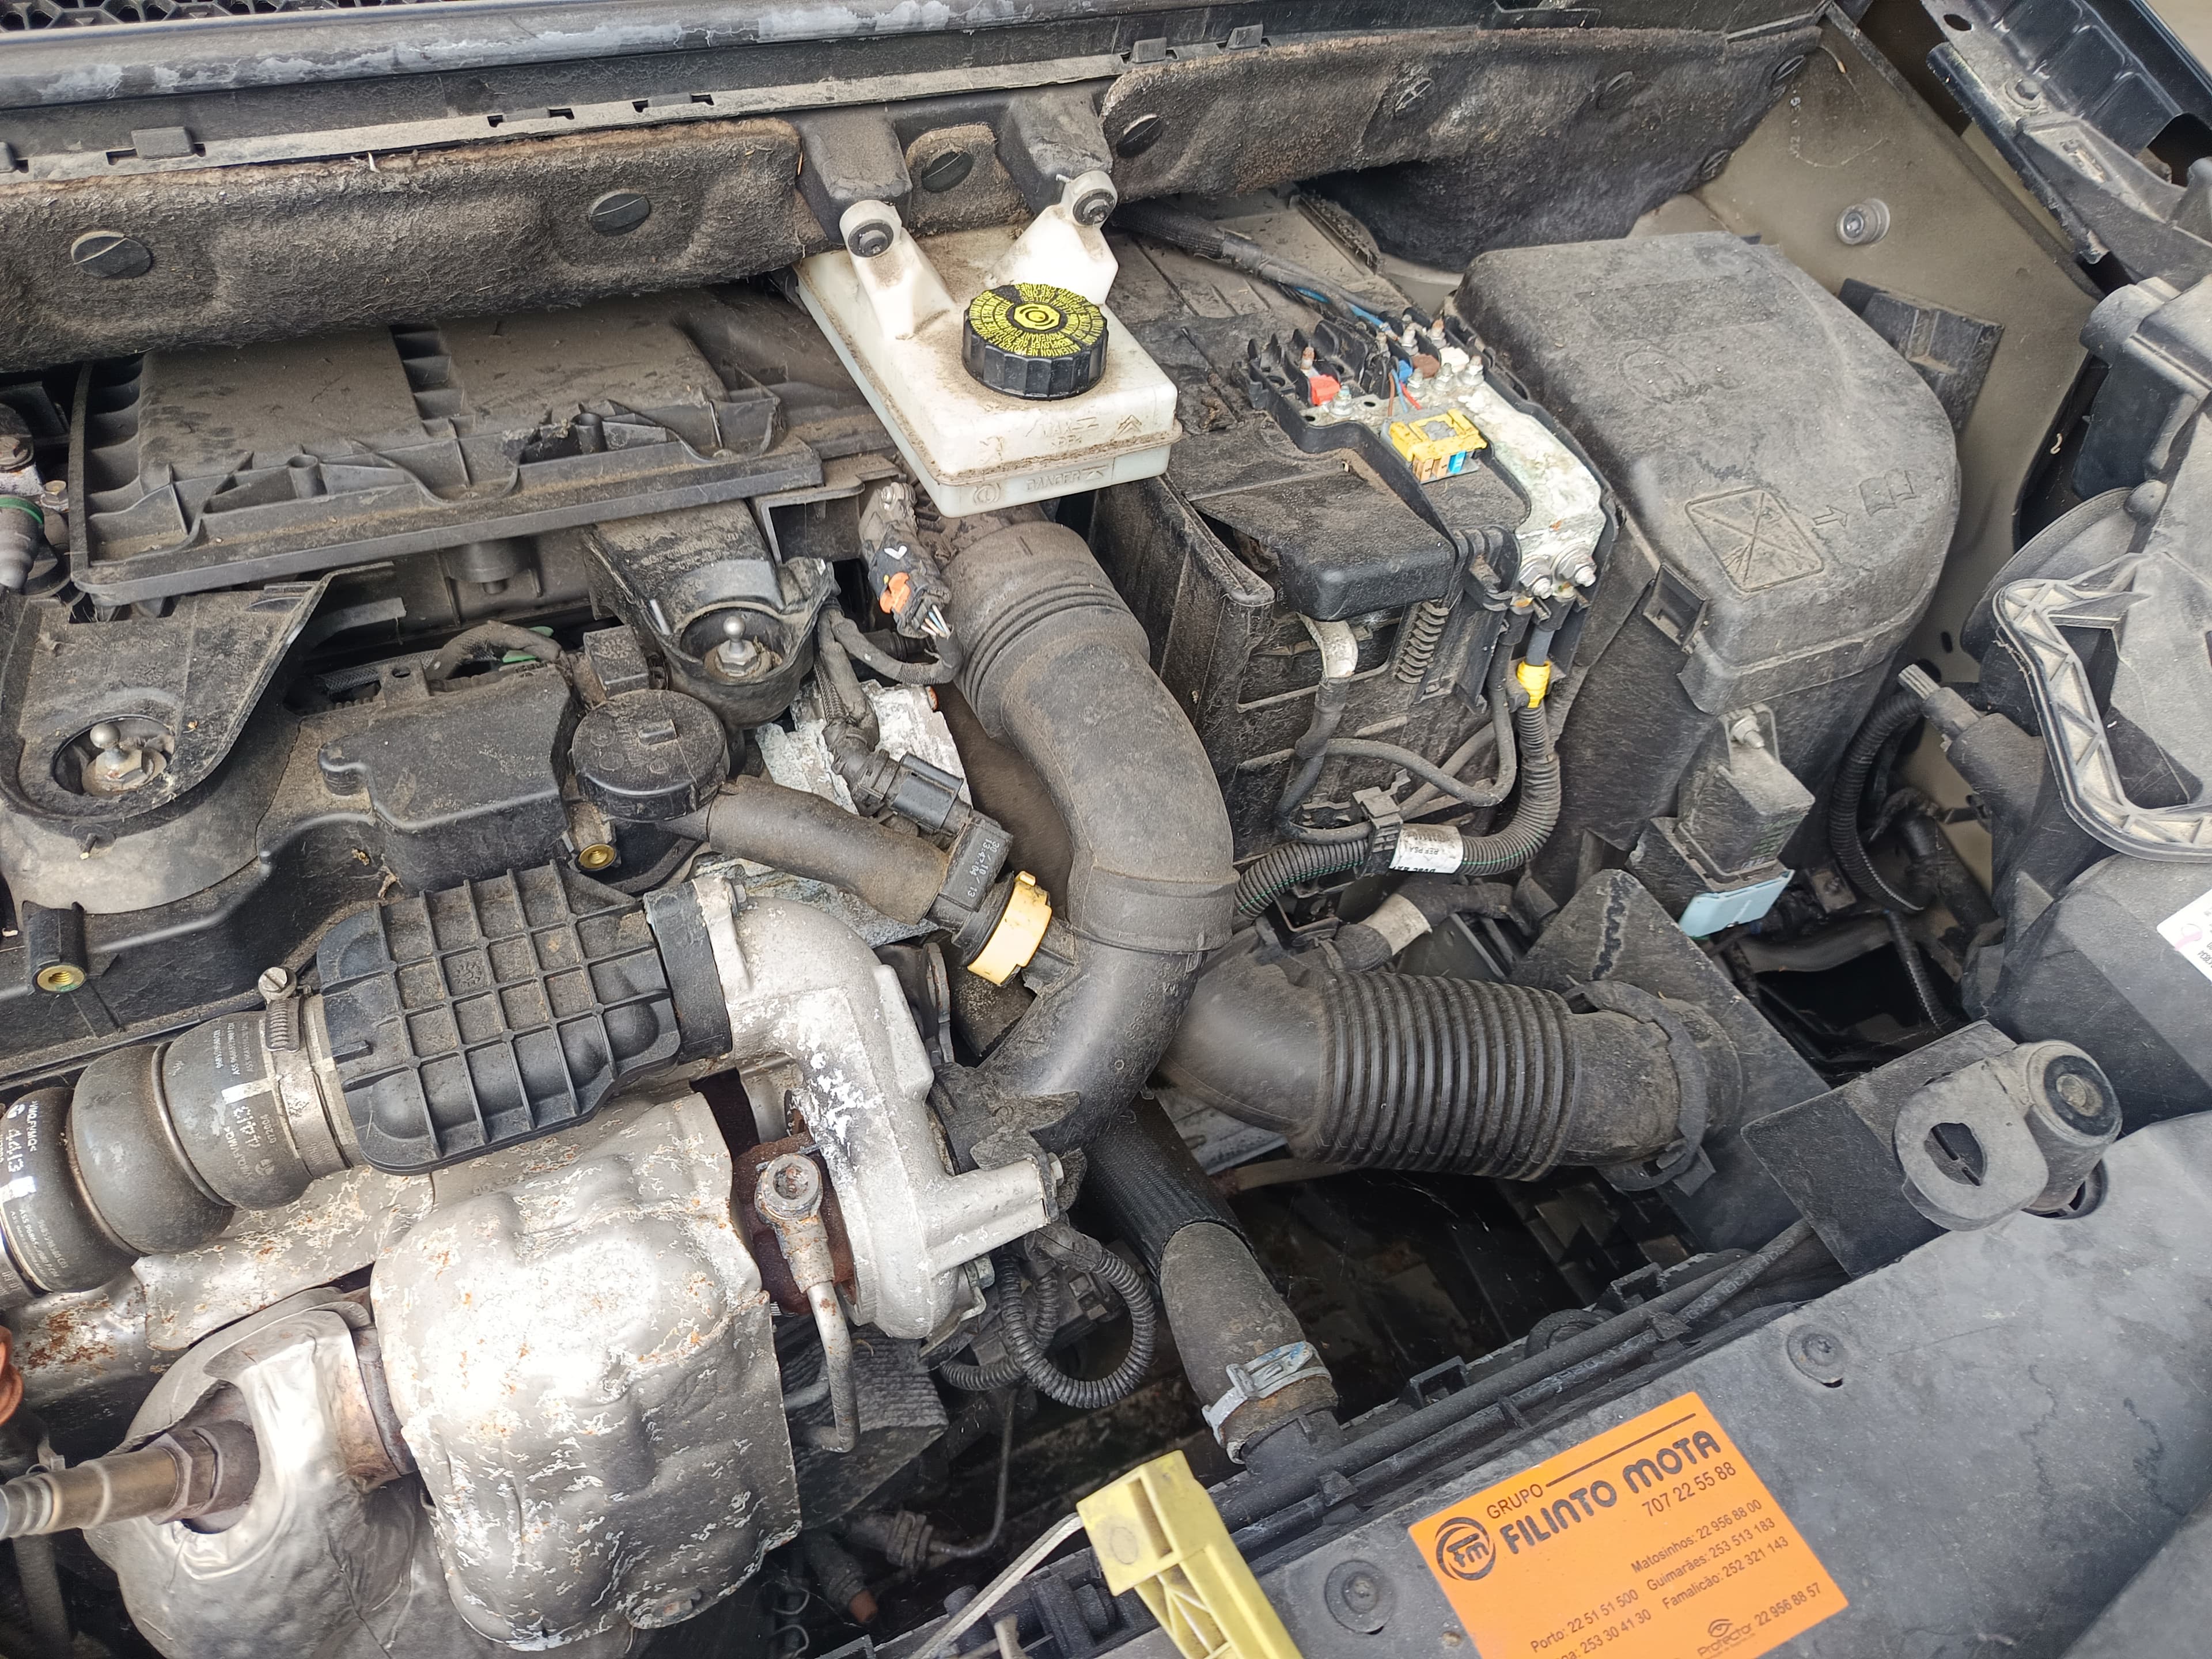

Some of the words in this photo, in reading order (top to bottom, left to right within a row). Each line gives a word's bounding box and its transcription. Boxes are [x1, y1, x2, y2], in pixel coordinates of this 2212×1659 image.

[1040, 290, 1056, 298] USE
[1040, 342, 1083, 358] ATTENTION
[969, 839, 993, 876] 13:47:04
[231, 1063, 241, 1075] ASS
[19, 1209, 29, 1224] ASS
[1486, 1483, 1544, 1520] GRUPO
[1499, 1480, 1618, 1555] FILINTO
[1622, 1430, 1721, 1494] MOTA
[1641, 1493, 1672, 1517] 707
[1672, 1482, 1695, 1502] 22
[1694, 1471, 1716, 1491] 55
[1714, 1461, 1737, 1480] 88
[1631, 1534, 1698, 1573] Matosinhos:
[1696, 1525, 1712, 1540] 22
[1711, 1514, 1733, 1532] 956
[1732, 1506, 1747, 1521] 88
[1746, 1499, 1762, 1513] 00
[1646, 1553, 1710, 1591] Guimarães:
[1709, 1540, 1731, 1558] 253
[1731, 1529, 1753, 1547] 513
[1754, 1517, 1775, 1534] 183
[1662, 1573, 1724, 1609] Famalicão:
[1722, 1559, 1745, 1577] 252
[1744, 1548, 1766, 1566] 321
[1767, 1536, 1789, 1554] 143
[1530, 1628, 1569, 1653] Porto:
[1567, 1617, 1584, 1633] 22
[1584, 1609, 1600, 1625] 51
[1600, 1601, 1616, 1616] 51
[1615, 1589, 1639, 1608] 500
[1580, 1634, 1604, 1654] 253
[1603, 1626, 1619, 1642] 30
[1621, 1617, 1635, 1632] 41
[1634, 1608, 1652, 1624] 30
[1697, 1622, 1752, 1657] Protector
[1753, 1611, 1771, 1626] 22
[1769, 1599, 1793, 1618] 956
[1791, 1590, 1808, 1607] 88
[1805, 1582, 1821, 1597] 57
